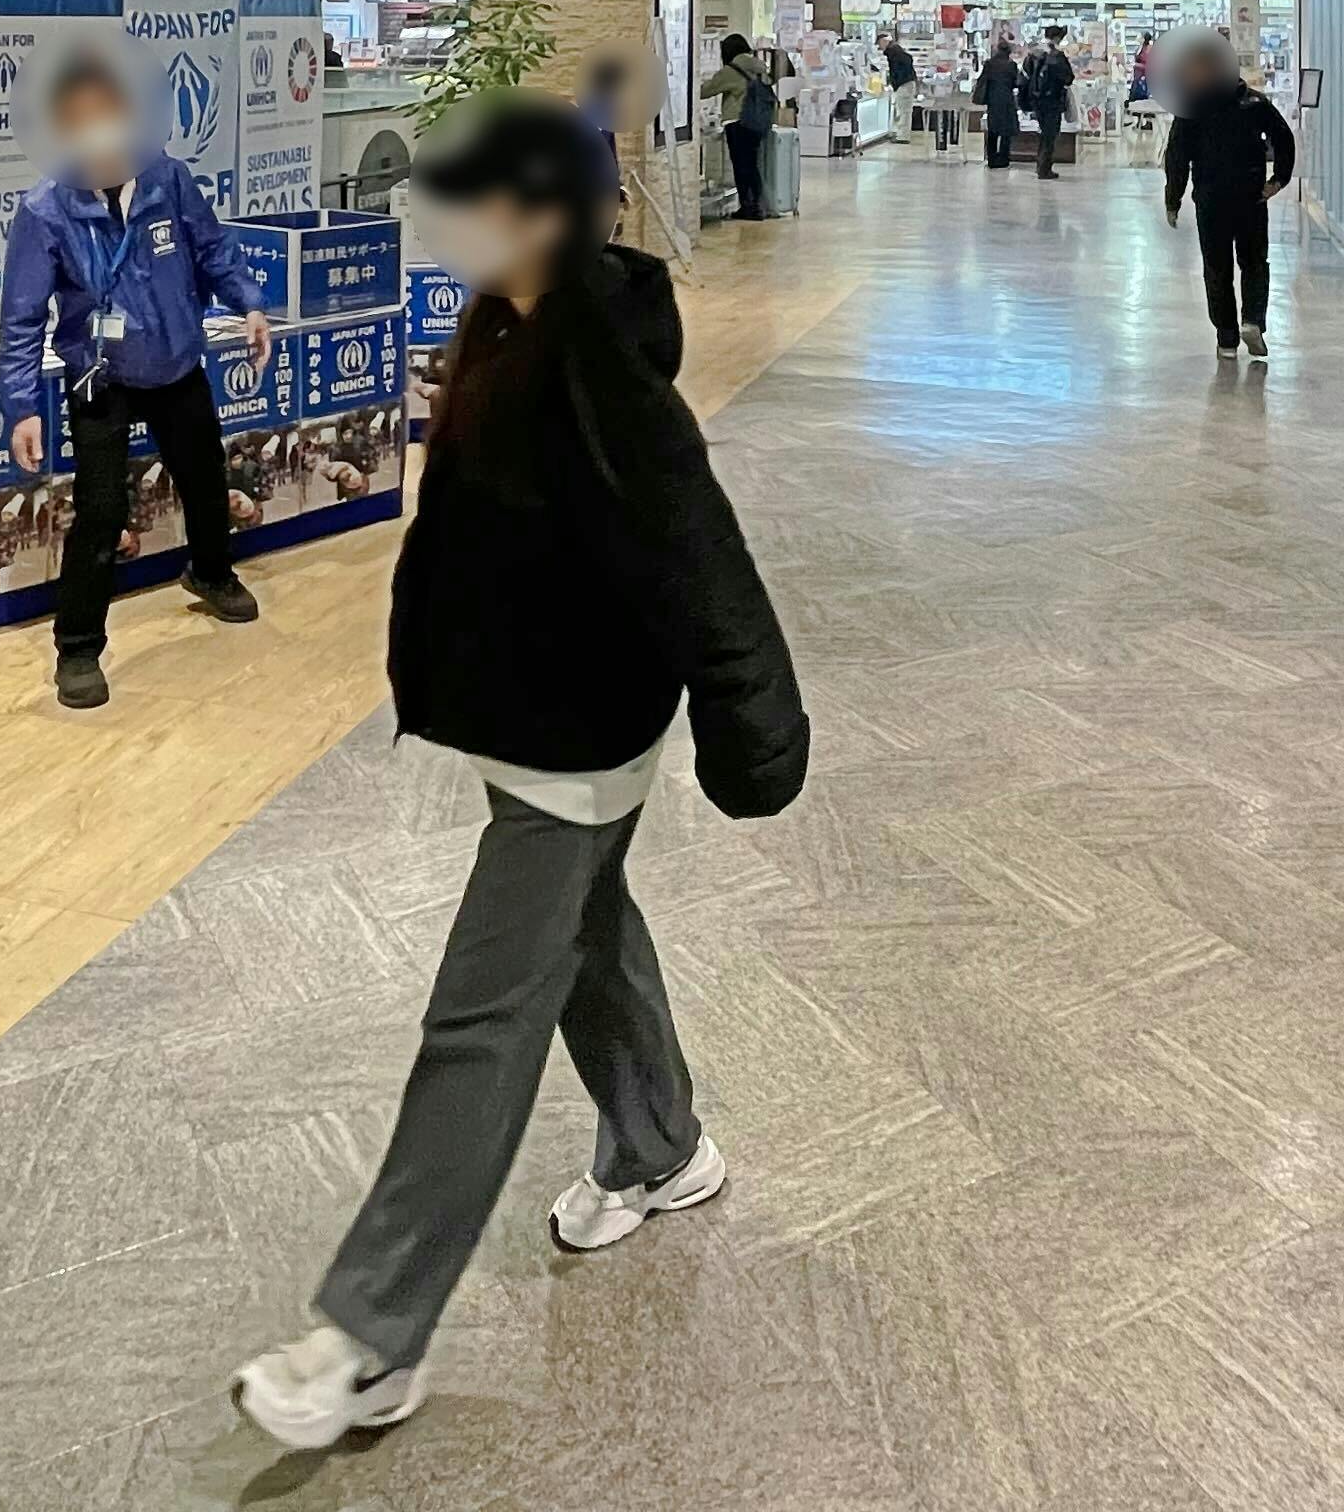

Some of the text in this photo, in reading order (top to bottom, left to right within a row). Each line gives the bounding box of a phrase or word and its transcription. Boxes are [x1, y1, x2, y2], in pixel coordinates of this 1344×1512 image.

[126, 13, 193, 39] JAPAN
[12, 34, 35, 47] FOR
[246, 91, 277, 108] UNHCR
[247, 166, 312, 195] DEVELOPMENT
[327, 264, 377, 287] 募集中
[381, 319, 397, 393] 1日100円で
[274, 338, 294, 417] 1日100円で
[307, 333, 322, 406] 助かる命
[330, 375, 376, 395] UNHCR
[218, 398, 268, 419] UNHCR
